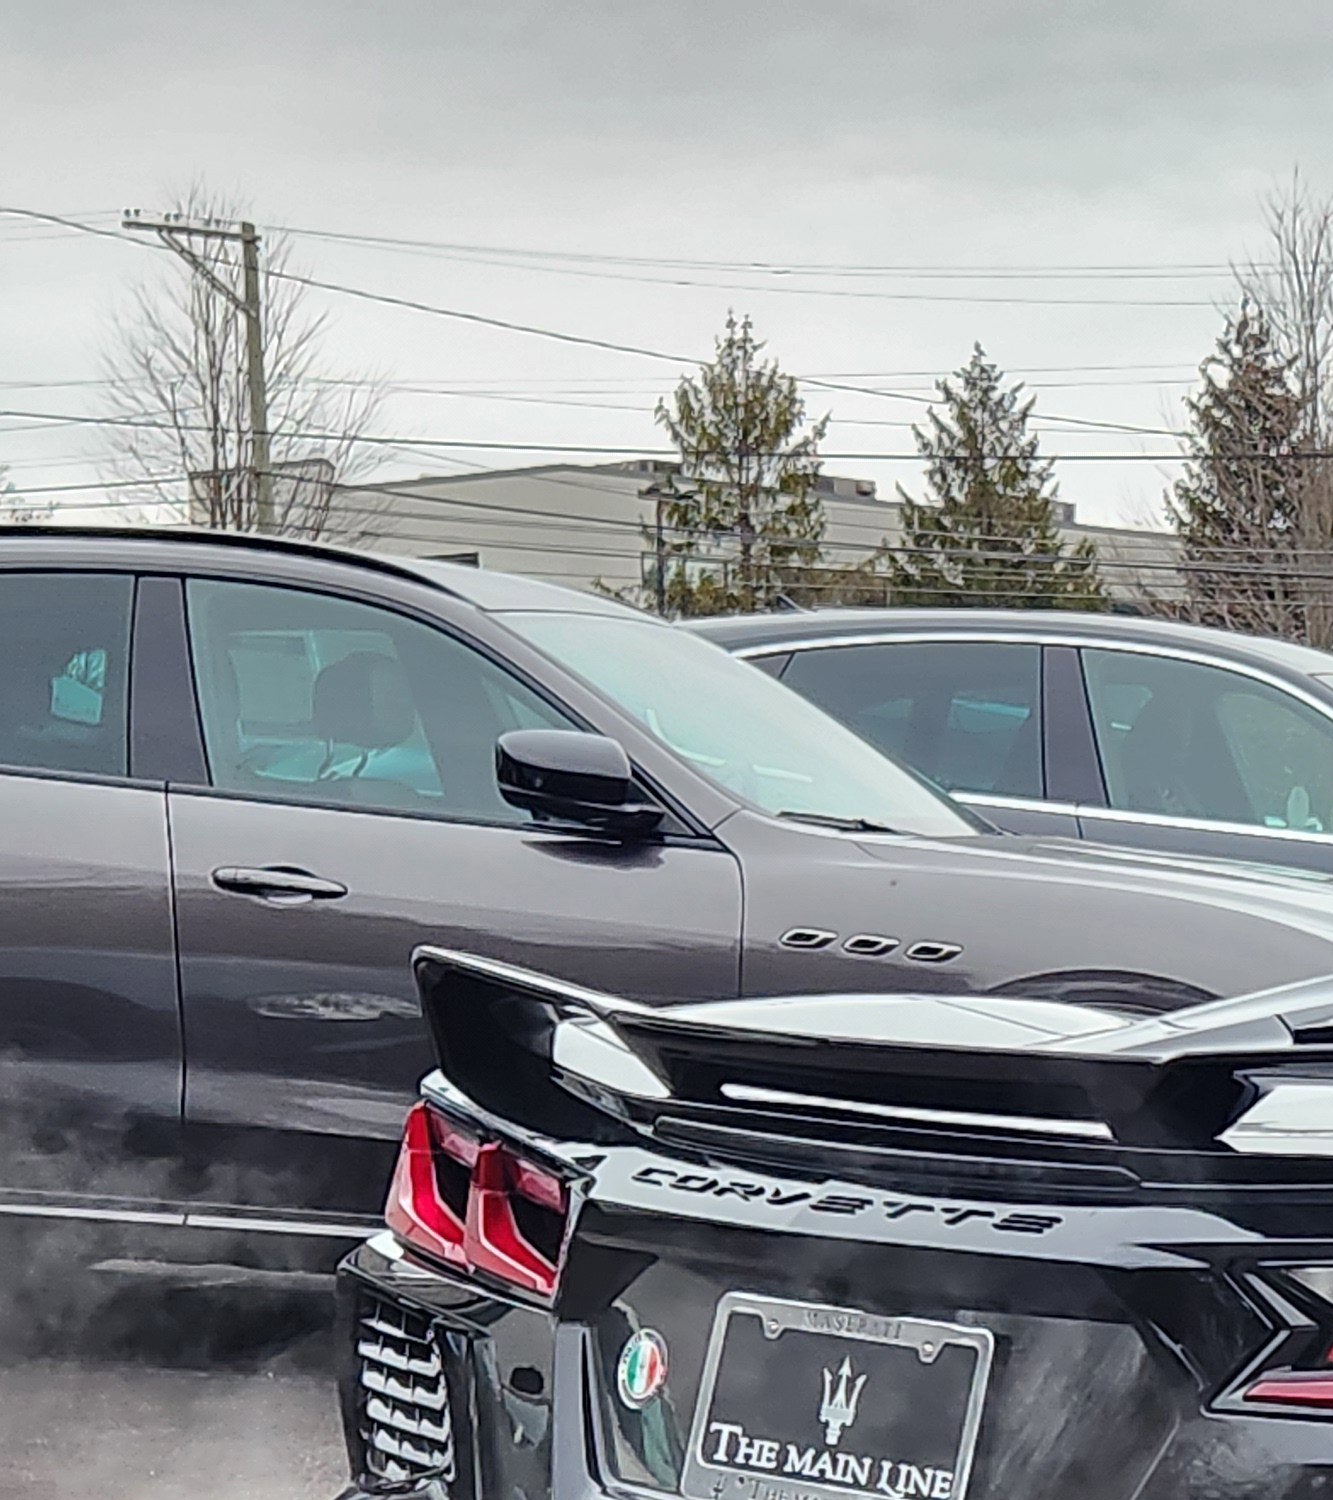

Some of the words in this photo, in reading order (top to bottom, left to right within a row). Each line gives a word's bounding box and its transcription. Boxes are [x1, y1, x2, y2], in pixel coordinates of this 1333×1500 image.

[630, 1165, 1065, 1236] CORVETTE
[709, 1420, 781, 1471] THE
[782, 1443, 873, 1487] MAIN
[875, 1459, 954, 1500] LINE
